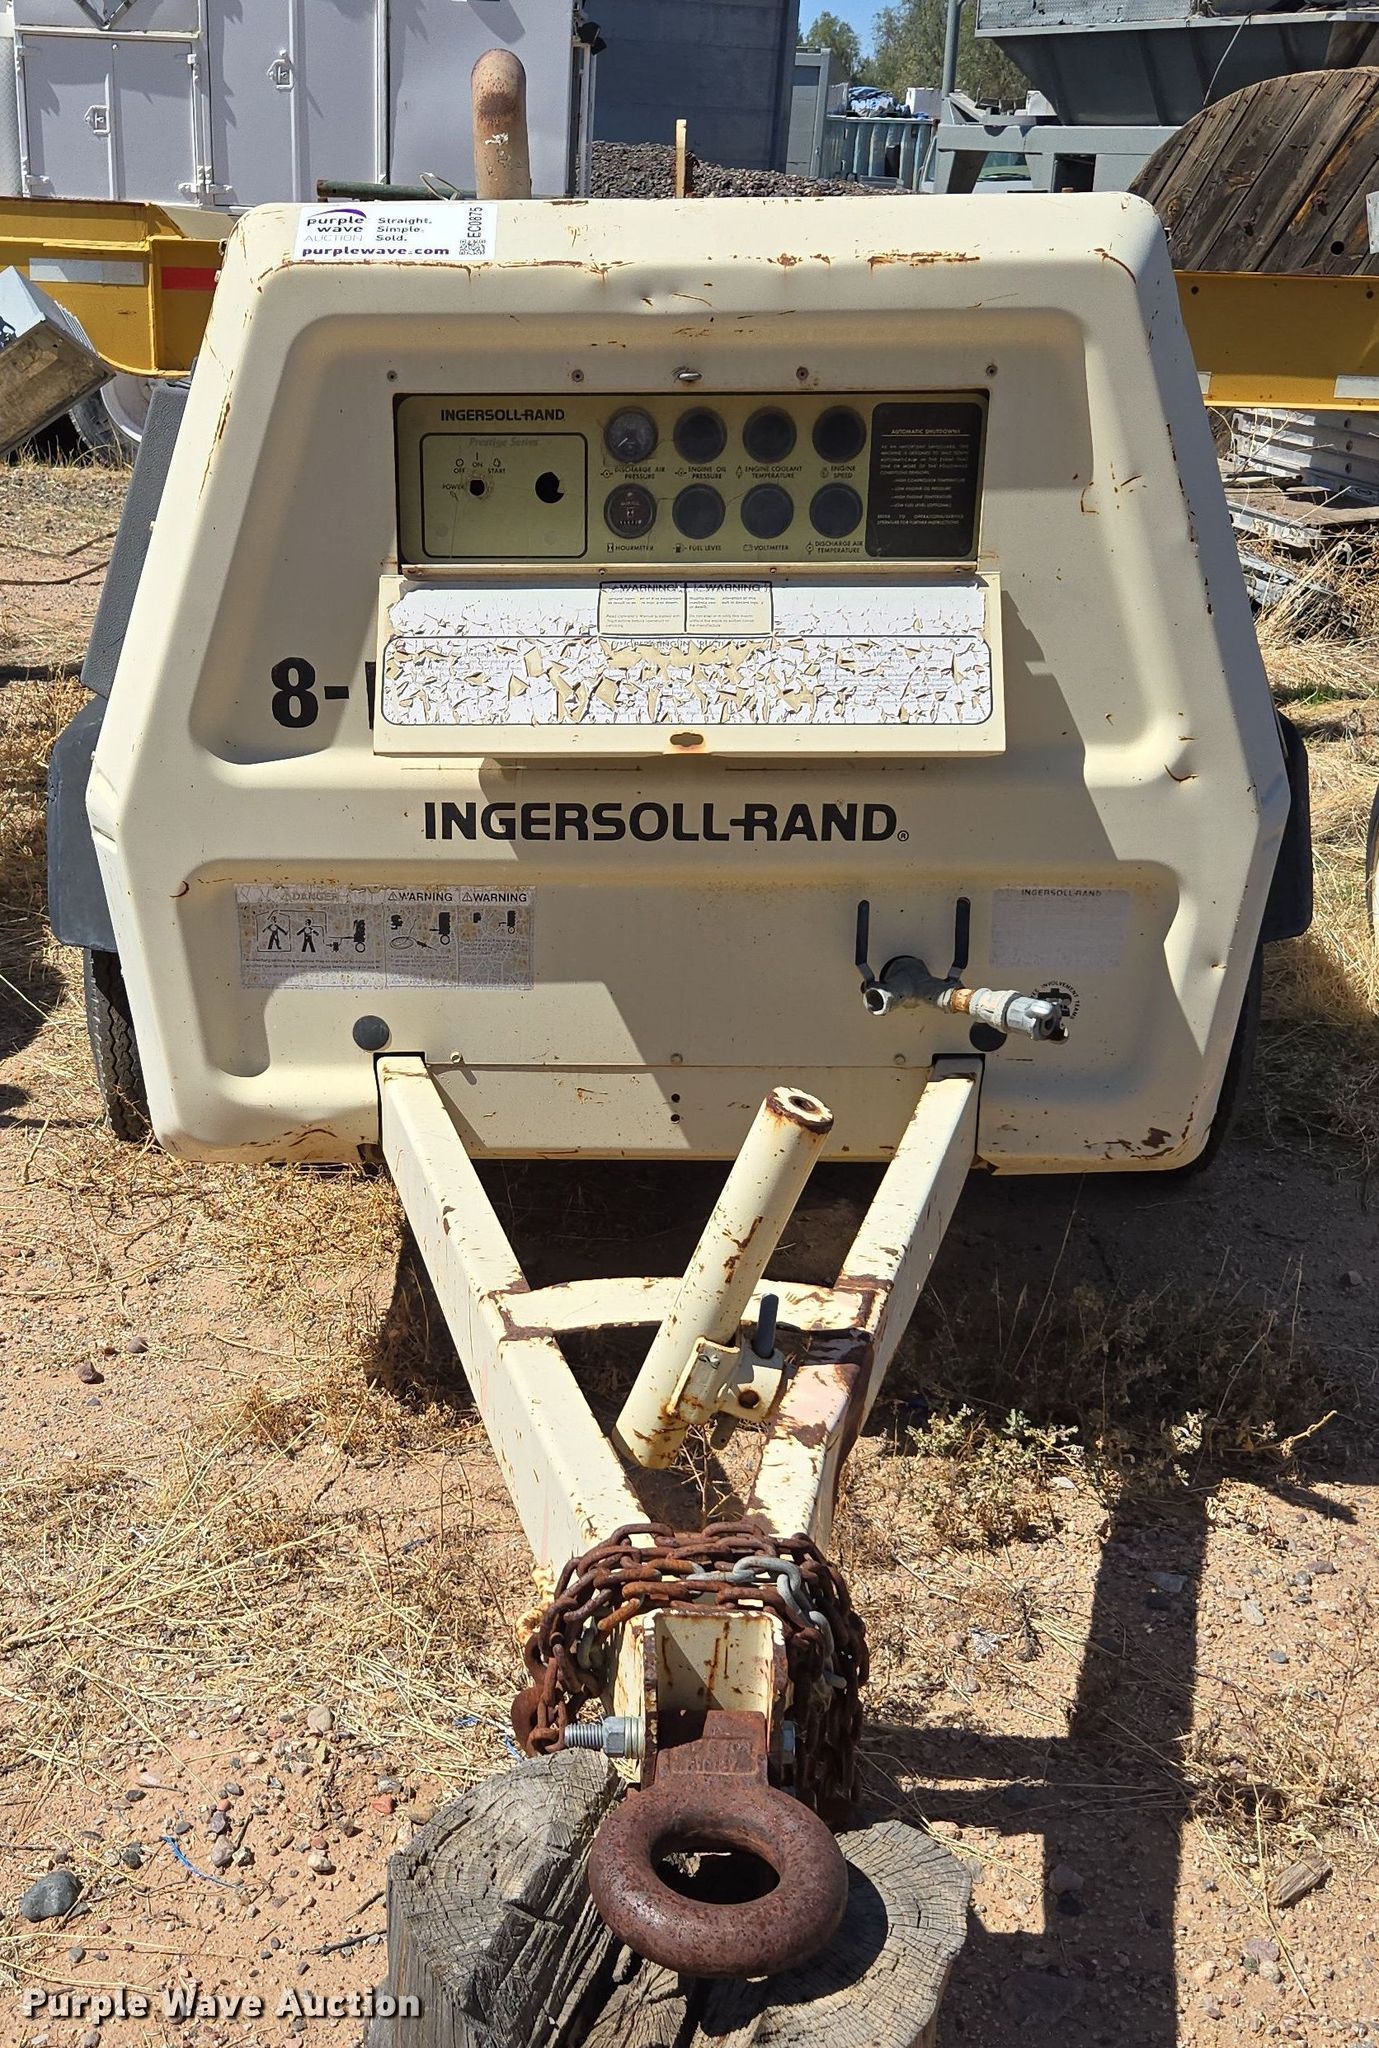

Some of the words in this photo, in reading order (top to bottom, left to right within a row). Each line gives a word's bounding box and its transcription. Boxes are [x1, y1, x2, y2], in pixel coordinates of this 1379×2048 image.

[306, 216, 365, 226] purple
[378, 217, 433, 225] Straight.
[467, 207, 483, 238] EC0875
[376, 225, 425, 234] Simple.
[304, 234, 363, 242] AUCTION
[375, 234, 407, 242] Sold.
[302, 246, 450, 257] purplewave.com
[440, 409, 565, 421] INGERSOLL-RAND
[706, 583, 761, 592] WARNING
[424, 802, 897, 842] INGERSOLL-RAND
[399, 892, 453, 902] WARNING
[473, 893, 527, 902] WARNING
